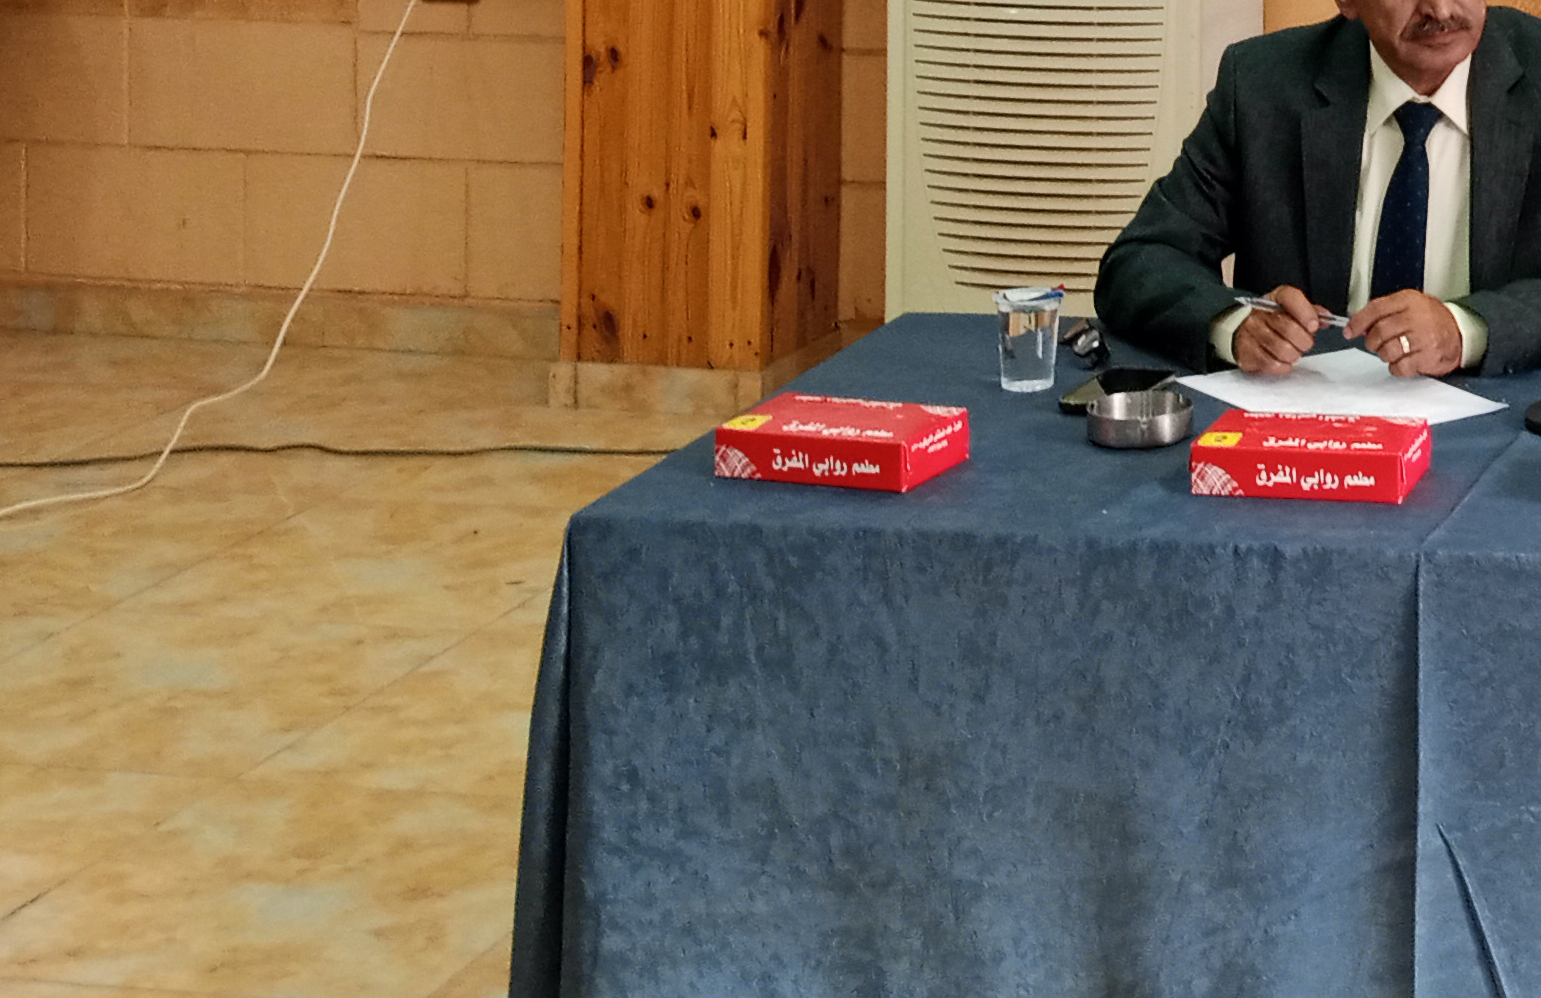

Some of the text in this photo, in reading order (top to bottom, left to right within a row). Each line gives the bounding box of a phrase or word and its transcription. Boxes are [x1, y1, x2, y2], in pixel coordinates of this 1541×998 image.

[772, 448, 880, 477] مطعم روابي المفرق
[1255, 463, 1375, 490] مطعم روابي المفرق
